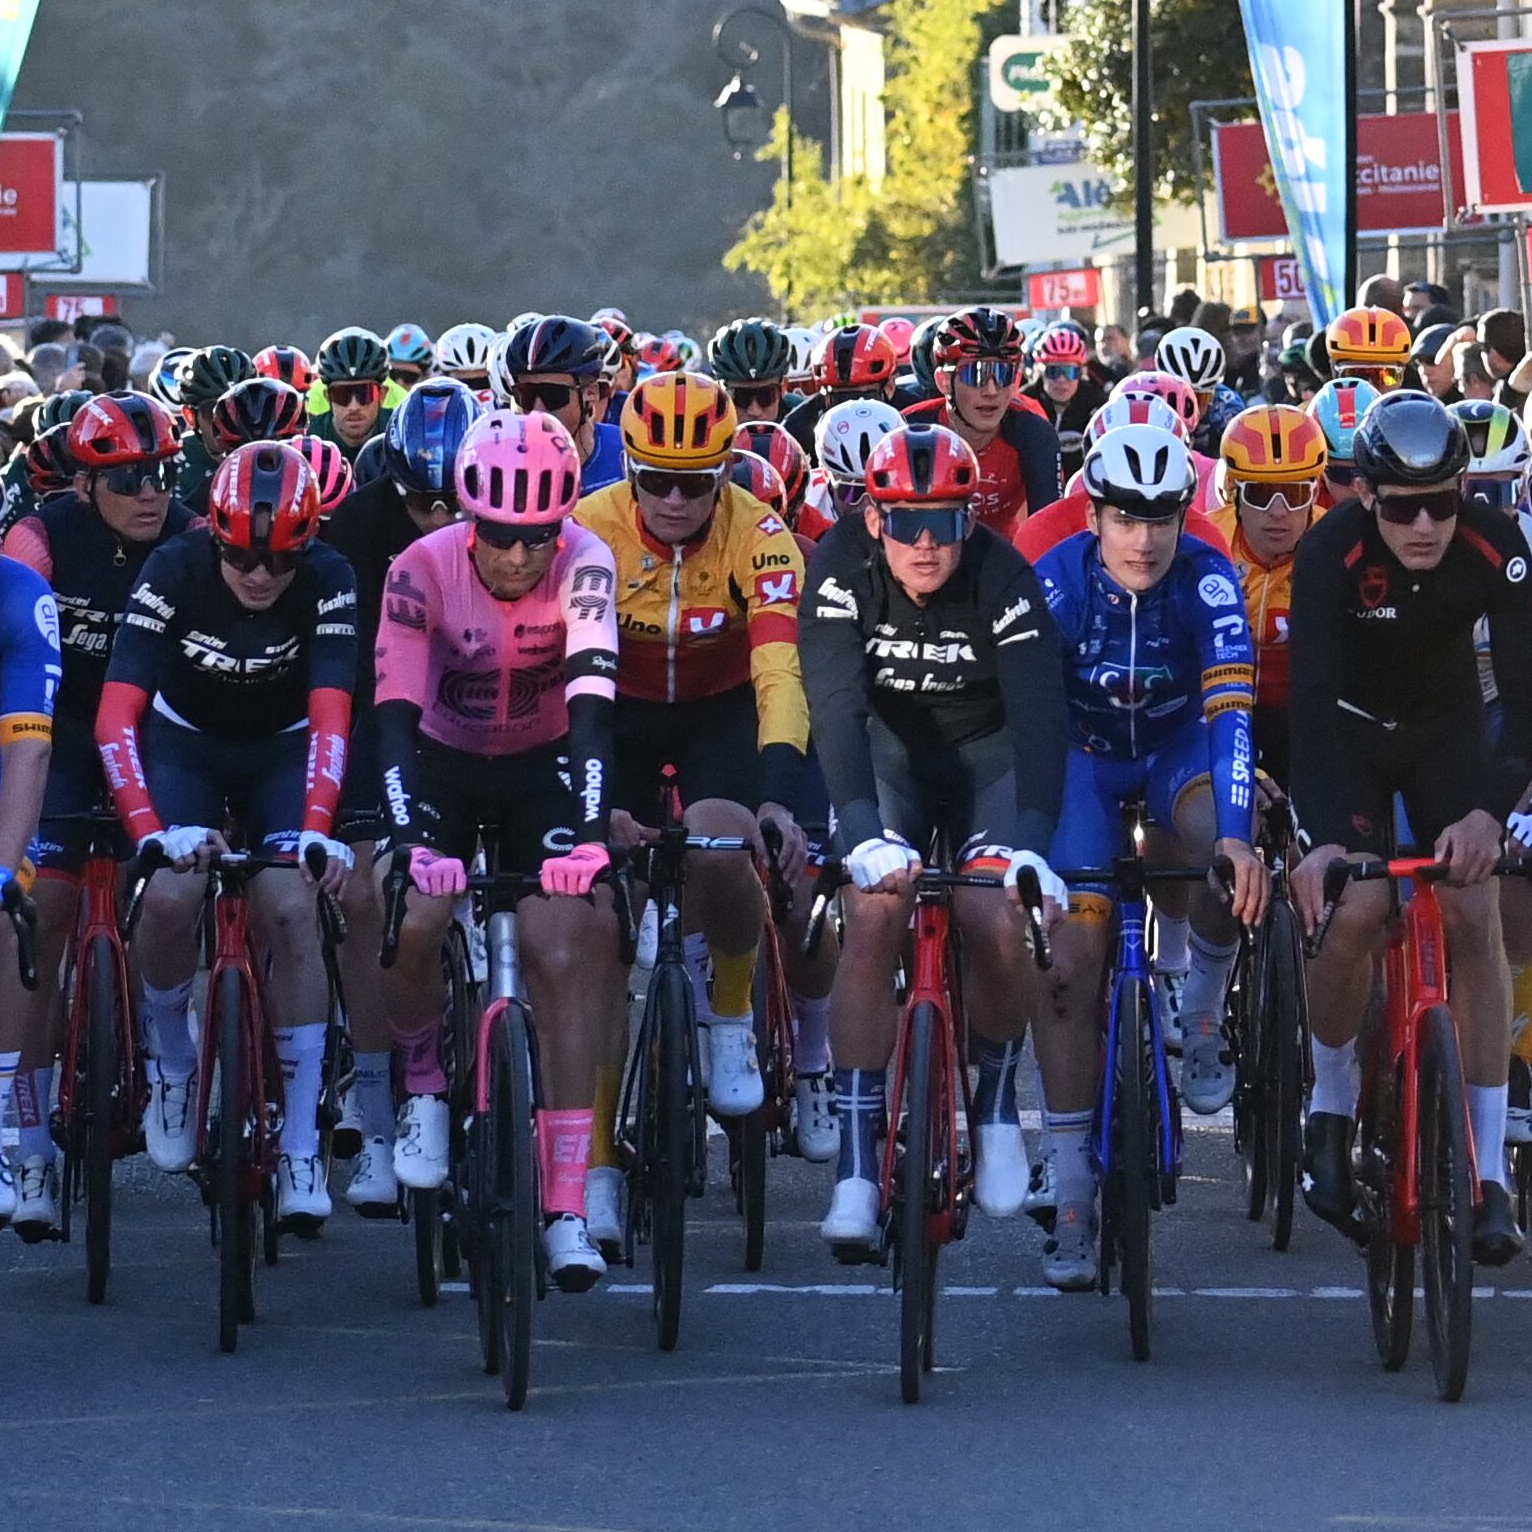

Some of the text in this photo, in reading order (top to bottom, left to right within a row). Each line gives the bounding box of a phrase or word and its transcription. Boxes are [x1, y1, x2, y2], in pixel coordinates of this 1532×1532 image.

[752, 552, 791, 570] Uno
[383, 764, 412, 826] wahoo
[579, 757, 603, 823] wahoo
[16, 1072, 37, 1127] TREK
